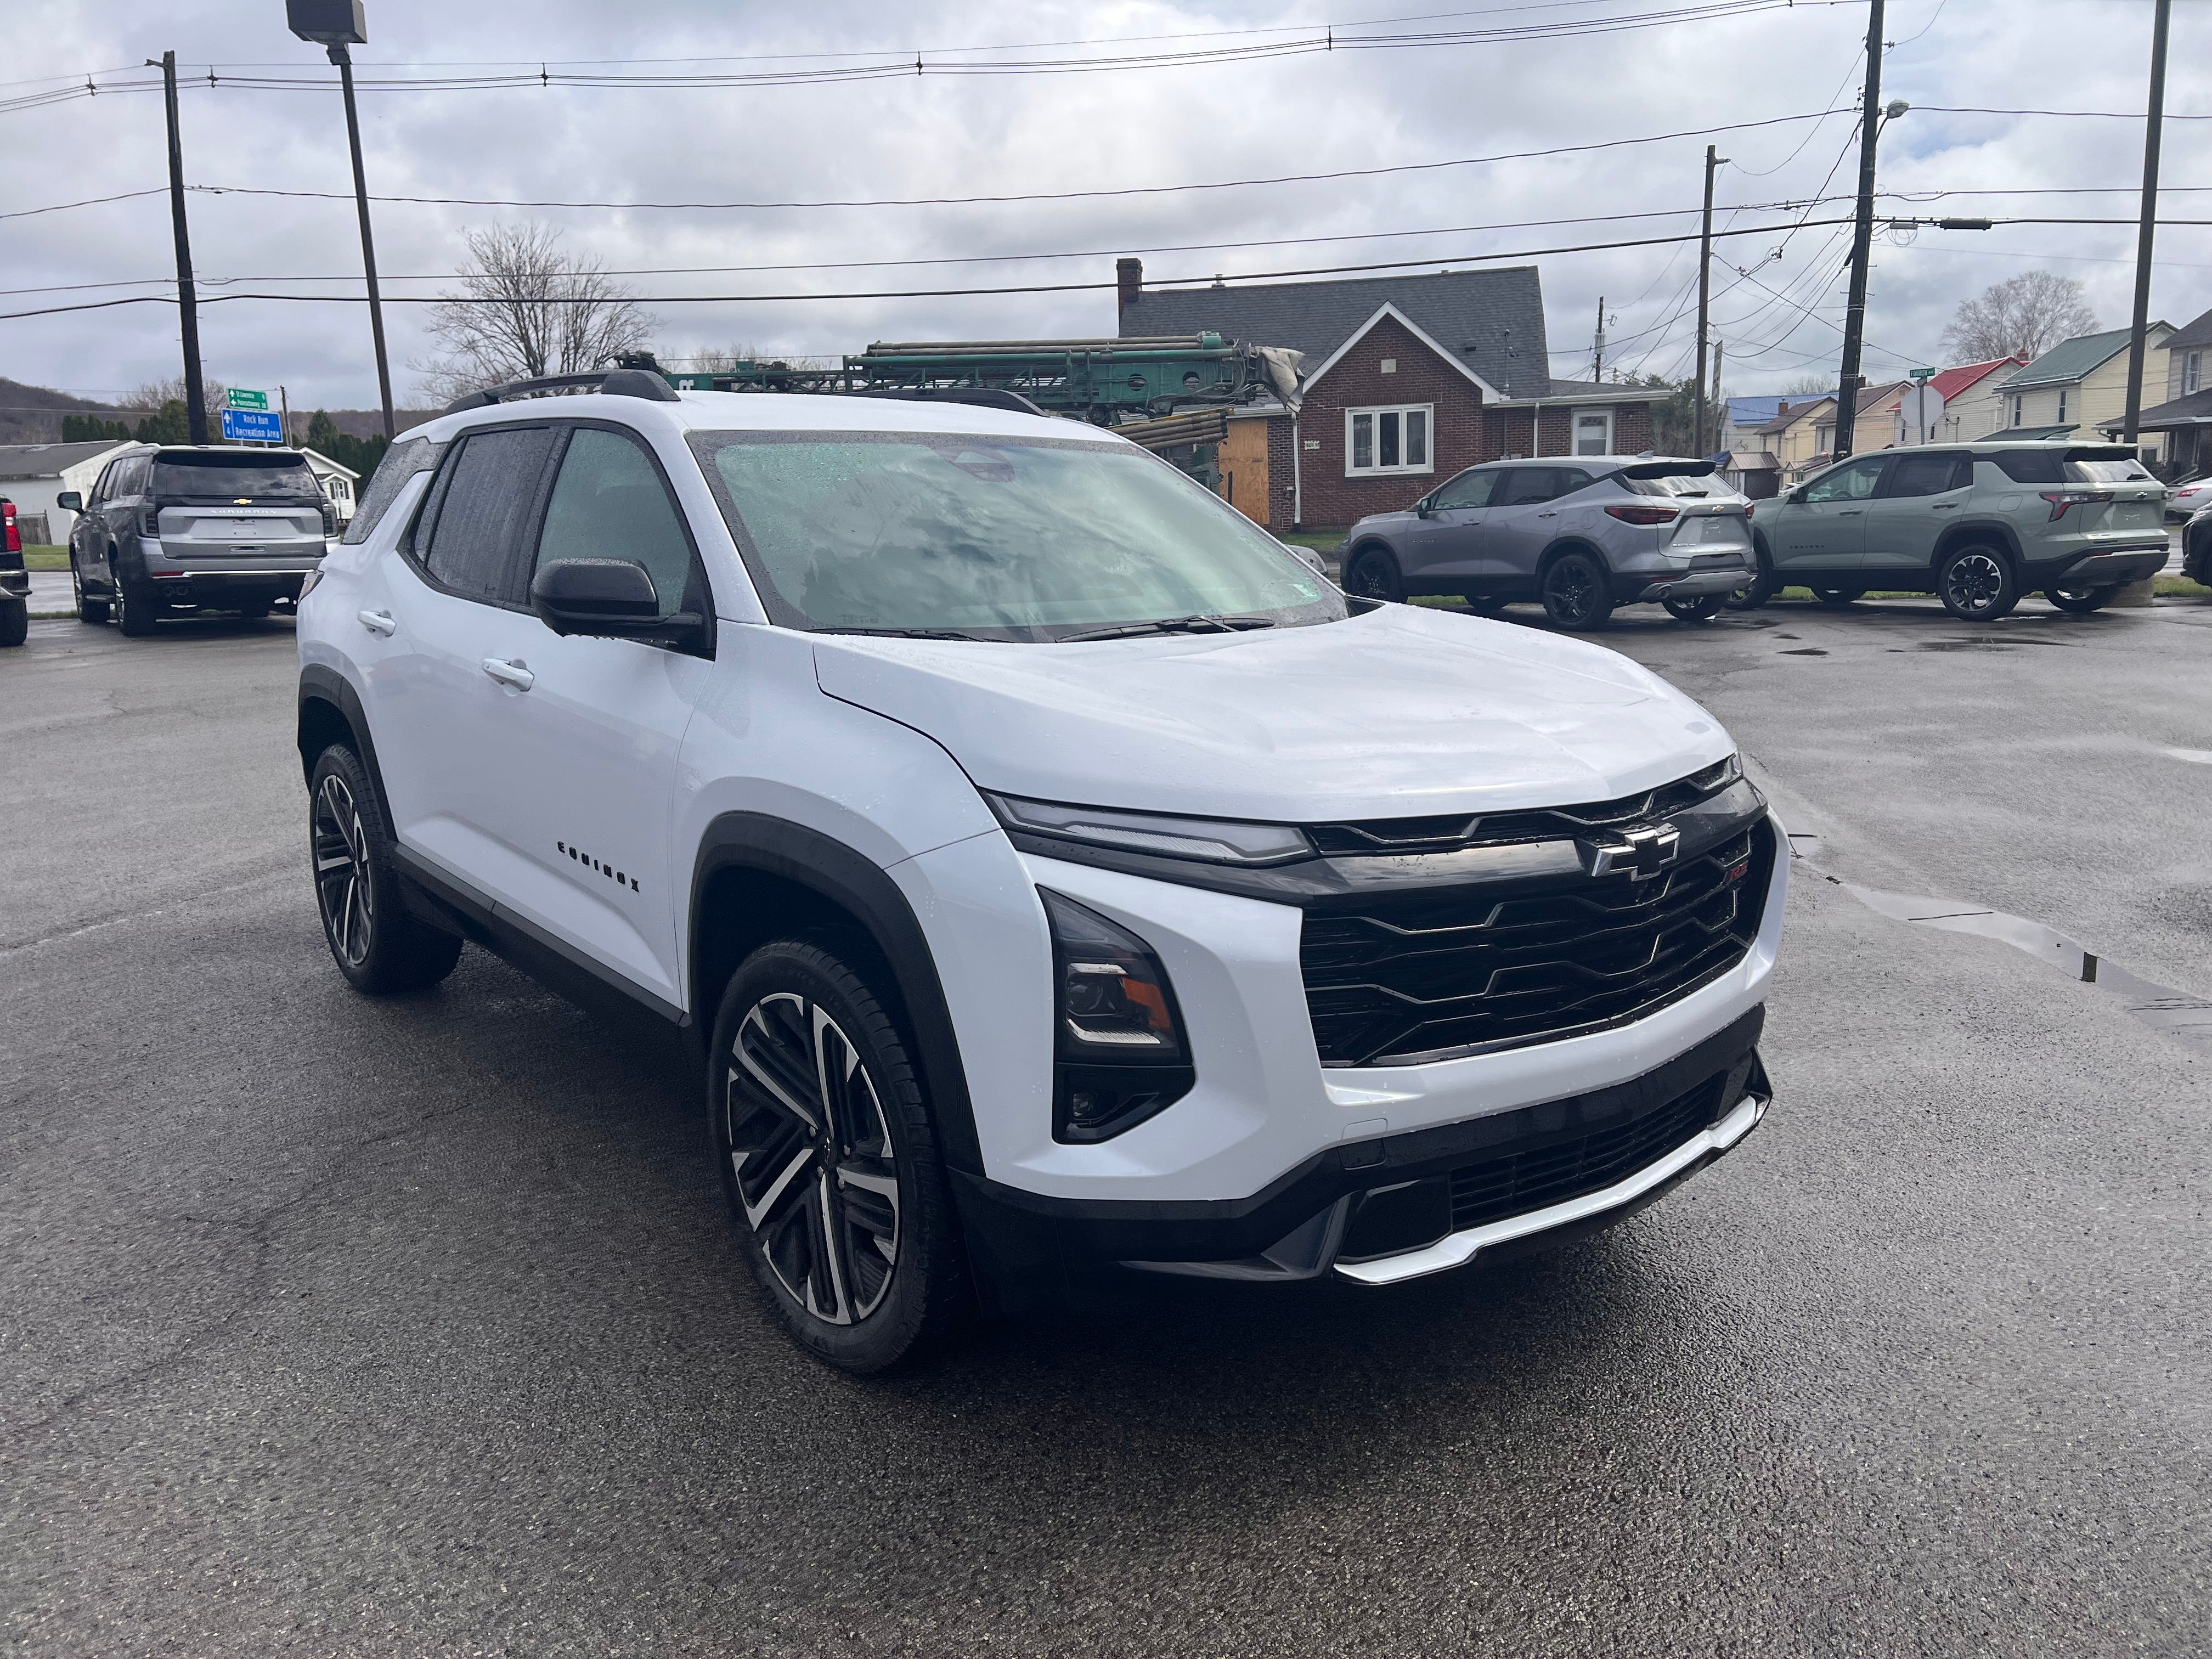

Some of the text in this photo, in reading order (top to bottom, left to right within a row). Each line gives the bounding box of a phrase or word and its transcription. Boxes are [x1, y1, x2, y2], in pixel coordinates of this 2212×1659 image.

[243, 414, 269, 425] Rock Run
[235, 427, 280, 439] Recreation Area
[557, 840, 640, 893] EQUINOX
